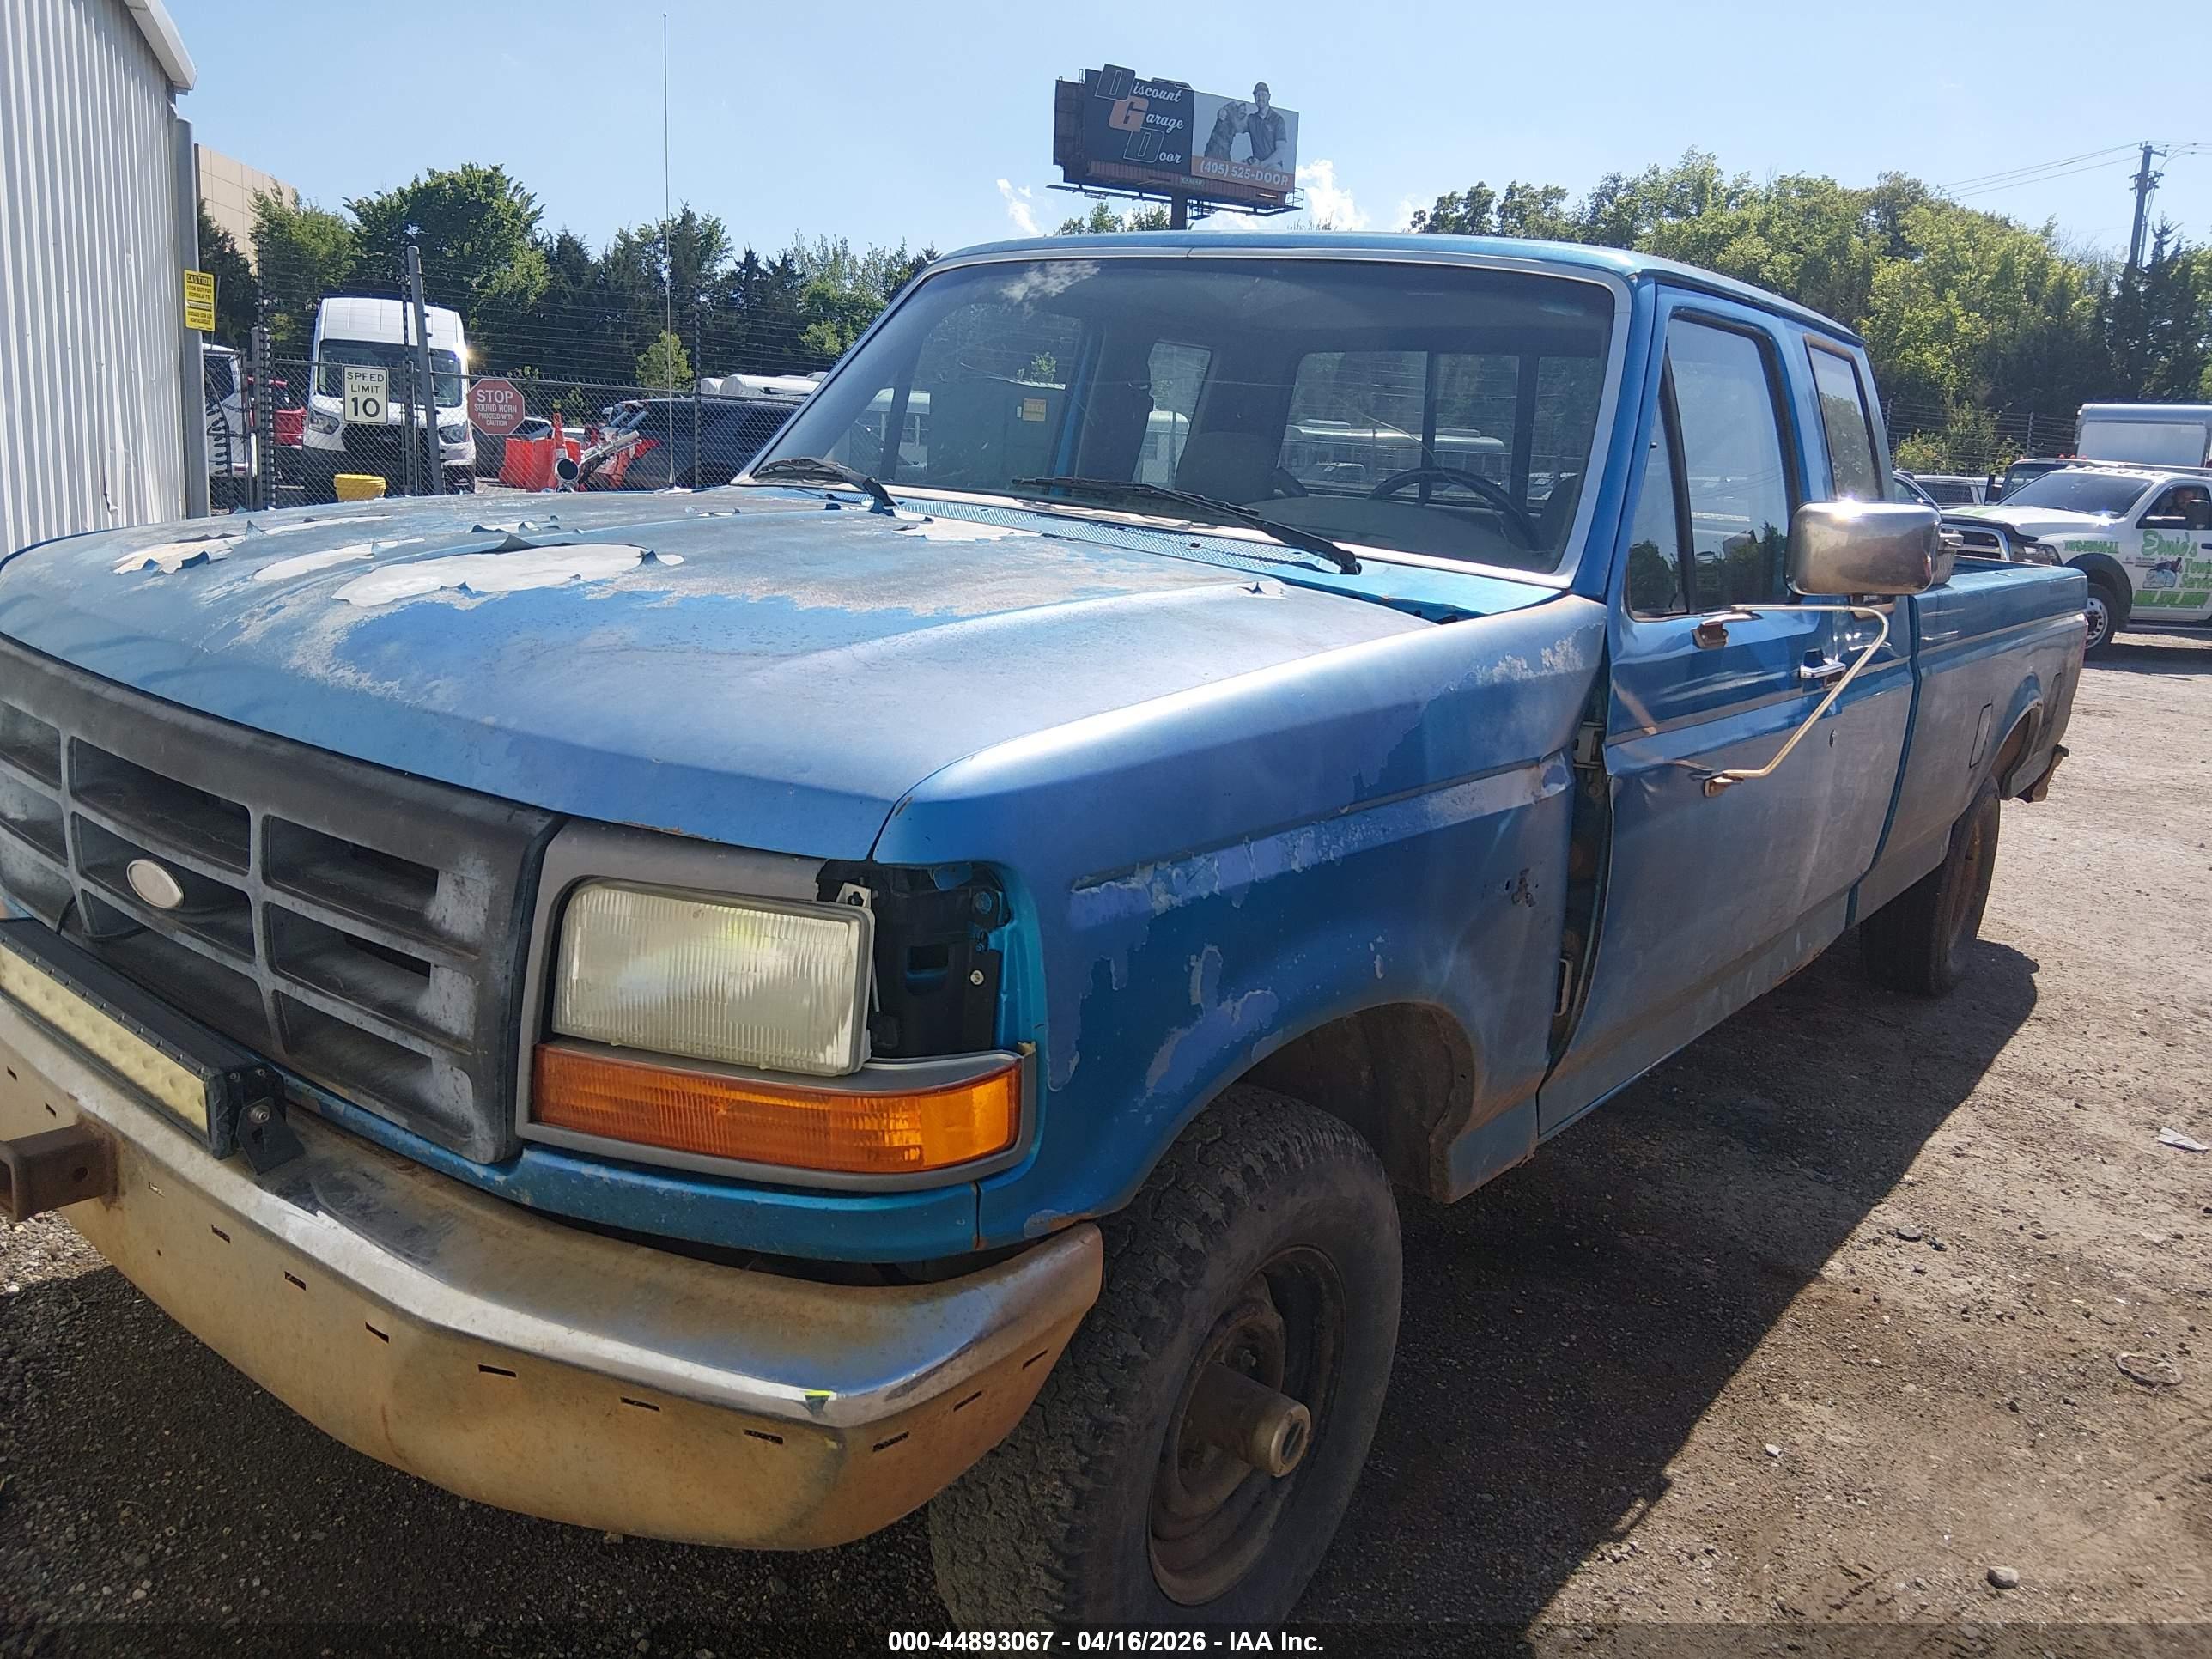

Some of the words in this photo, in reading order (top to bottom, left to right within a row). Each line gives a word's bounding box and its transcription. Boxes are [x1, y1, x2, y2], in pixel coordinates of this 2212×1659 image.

[1095, 64, 1182, 102] Discount
[1109, 96, 1183, 133] Garage
[1123, 127, 1182, 163] Door
[1200, 160, 1229, 177] (405)
[1231, 167, 1289, 186] 525-DOOR
[347, 372, 385, 382] SPEED
[350, 384, 380, 394] LIMIT
[476, 389, 514, 404] STOP
[351, 397, 380, 417] 10
[474, 403, 497, 412] SOUND
[498, 404, 517, 413] HORN
